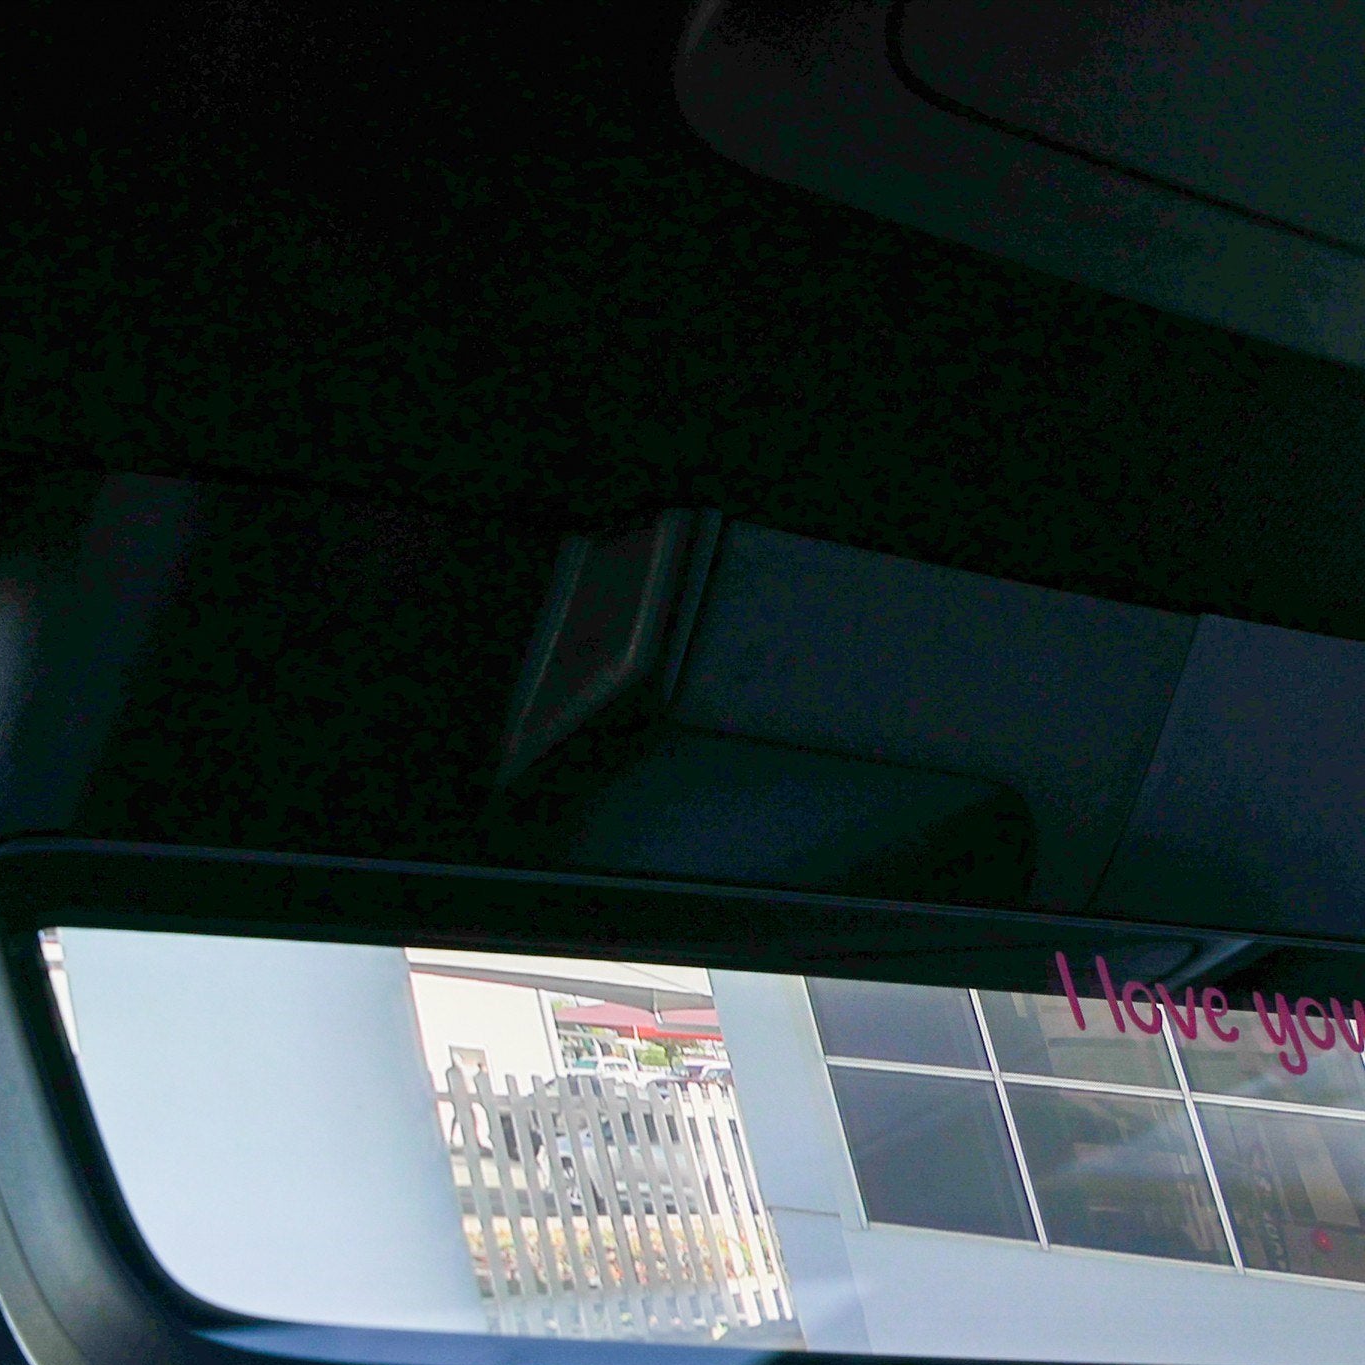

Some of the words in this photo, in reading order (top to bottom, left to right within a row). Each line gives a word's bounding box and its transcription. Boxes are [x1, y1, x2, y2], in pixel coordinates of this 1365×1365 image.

[1055, 951, 1086, 1031] I
[1095, 955, 1240, 1043] love
[1253, 991, 1365, 1076] you
